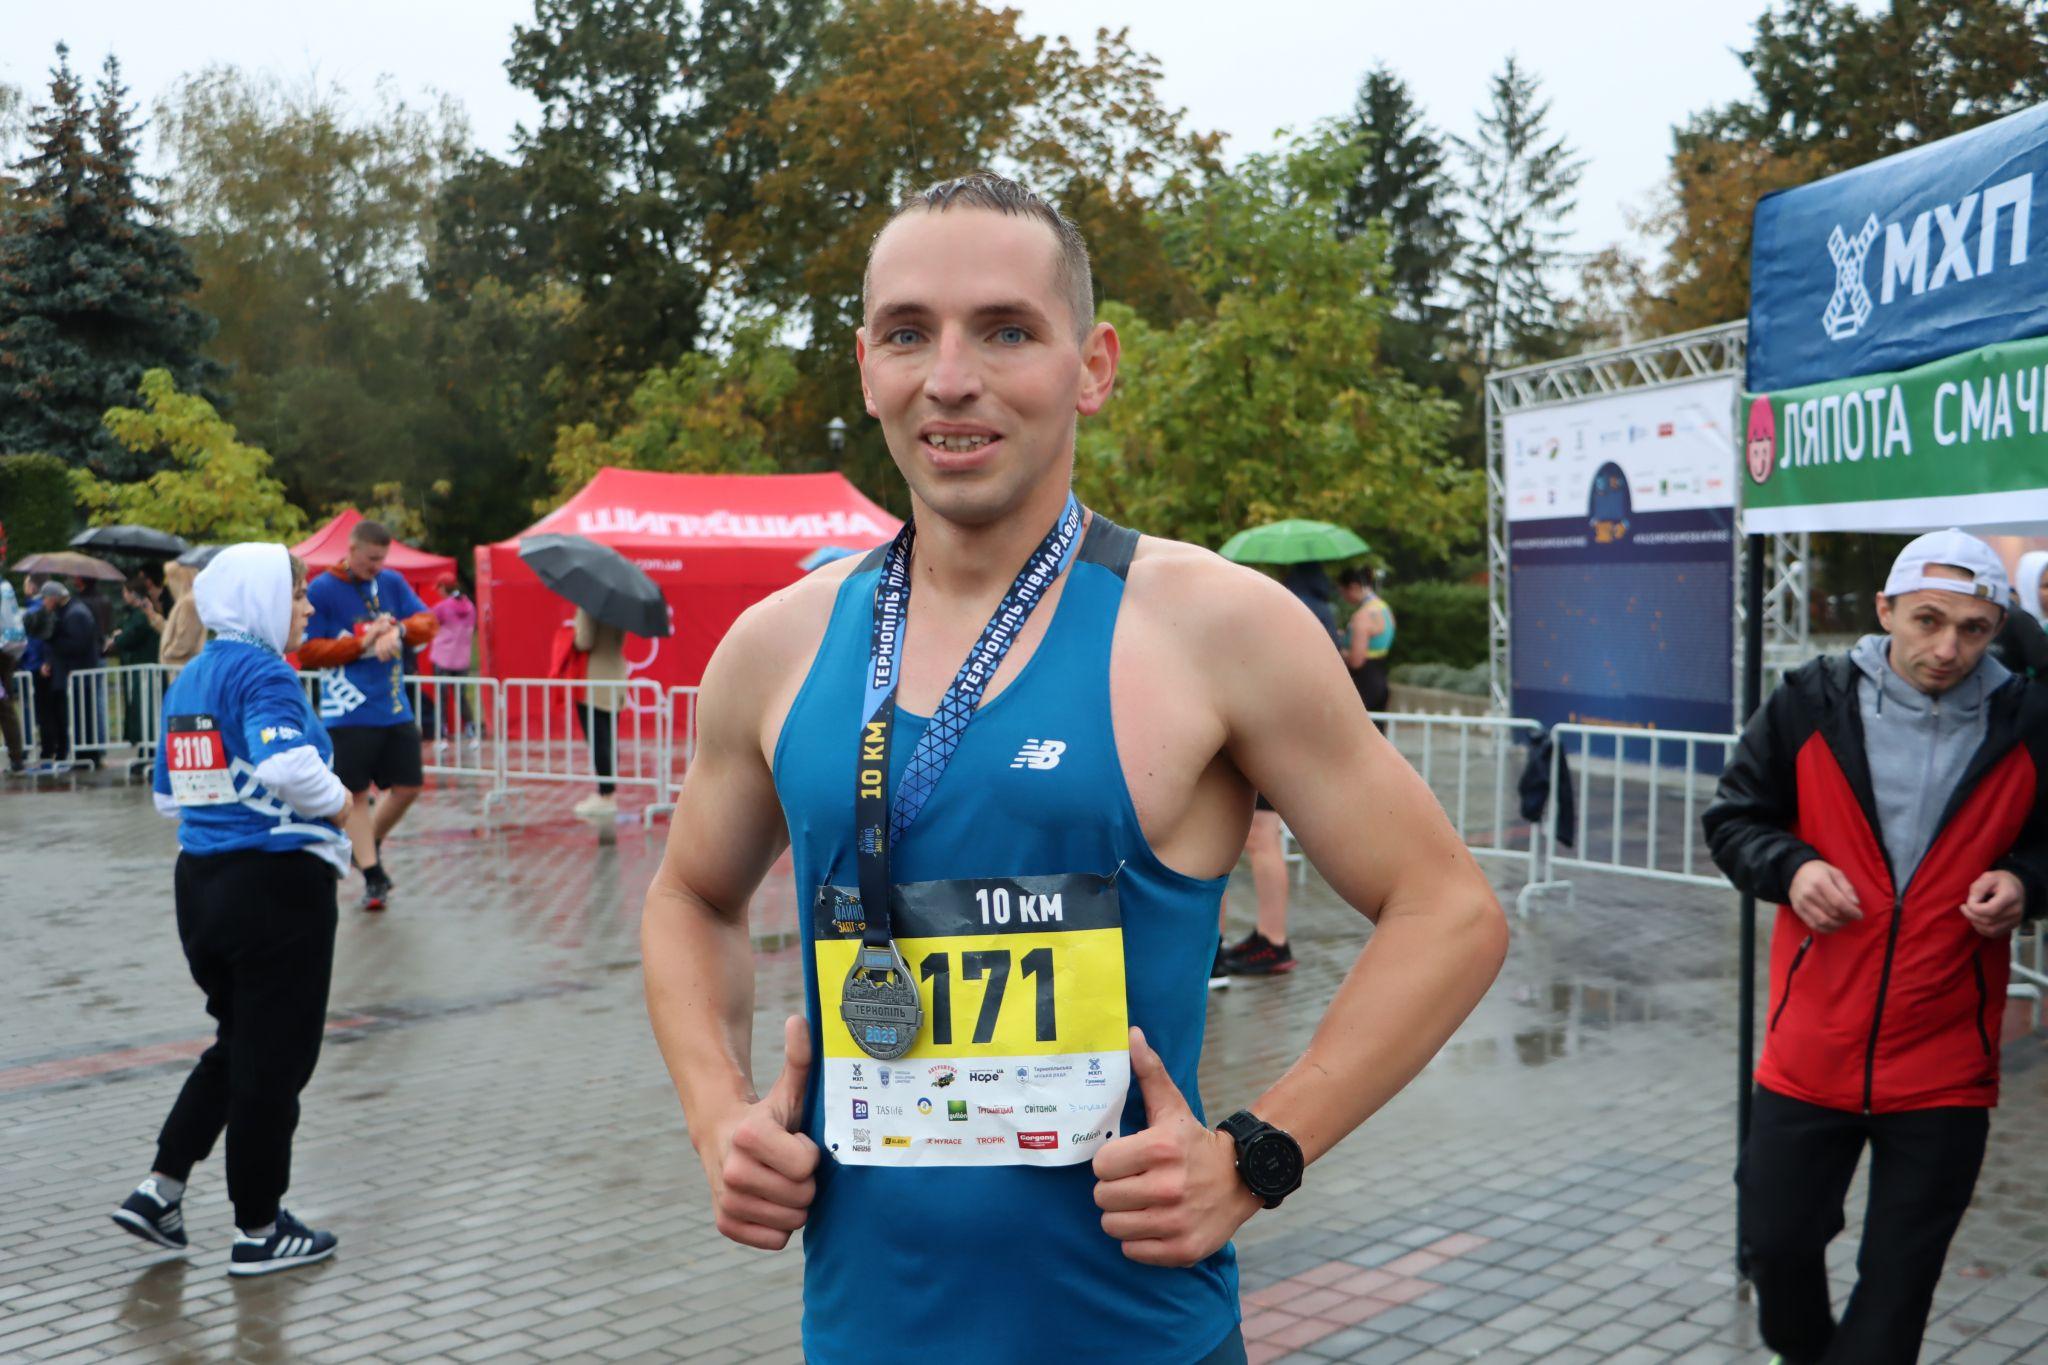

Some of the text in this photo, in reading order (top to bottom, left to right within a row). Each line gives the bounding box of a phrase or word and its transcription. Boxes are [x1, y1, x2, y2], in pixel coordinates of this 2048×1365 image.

[1880, 172, 2034, 305] МХП
[1780, 364, 2048, 469] ЛЯПОТА СМАЧ
[960, 507, 1080, 692] ТЕРНОПІЛЬ ПІВМАРАФОН
[873, 592, 900, 688] ТЕРНОПІЛЬ
[174, 735, 213, 769] 3110
[860, 769, 883, 800] 10
[976, 887, 1010, 925] 10
[855, 1005, 906, 1018] ТЕРНОПІЛЬ
[865, 1025, 897, 1044] 2023
[969, 1072, 999, 1083] Hope
[855, 1102, 867, 1114] 20
